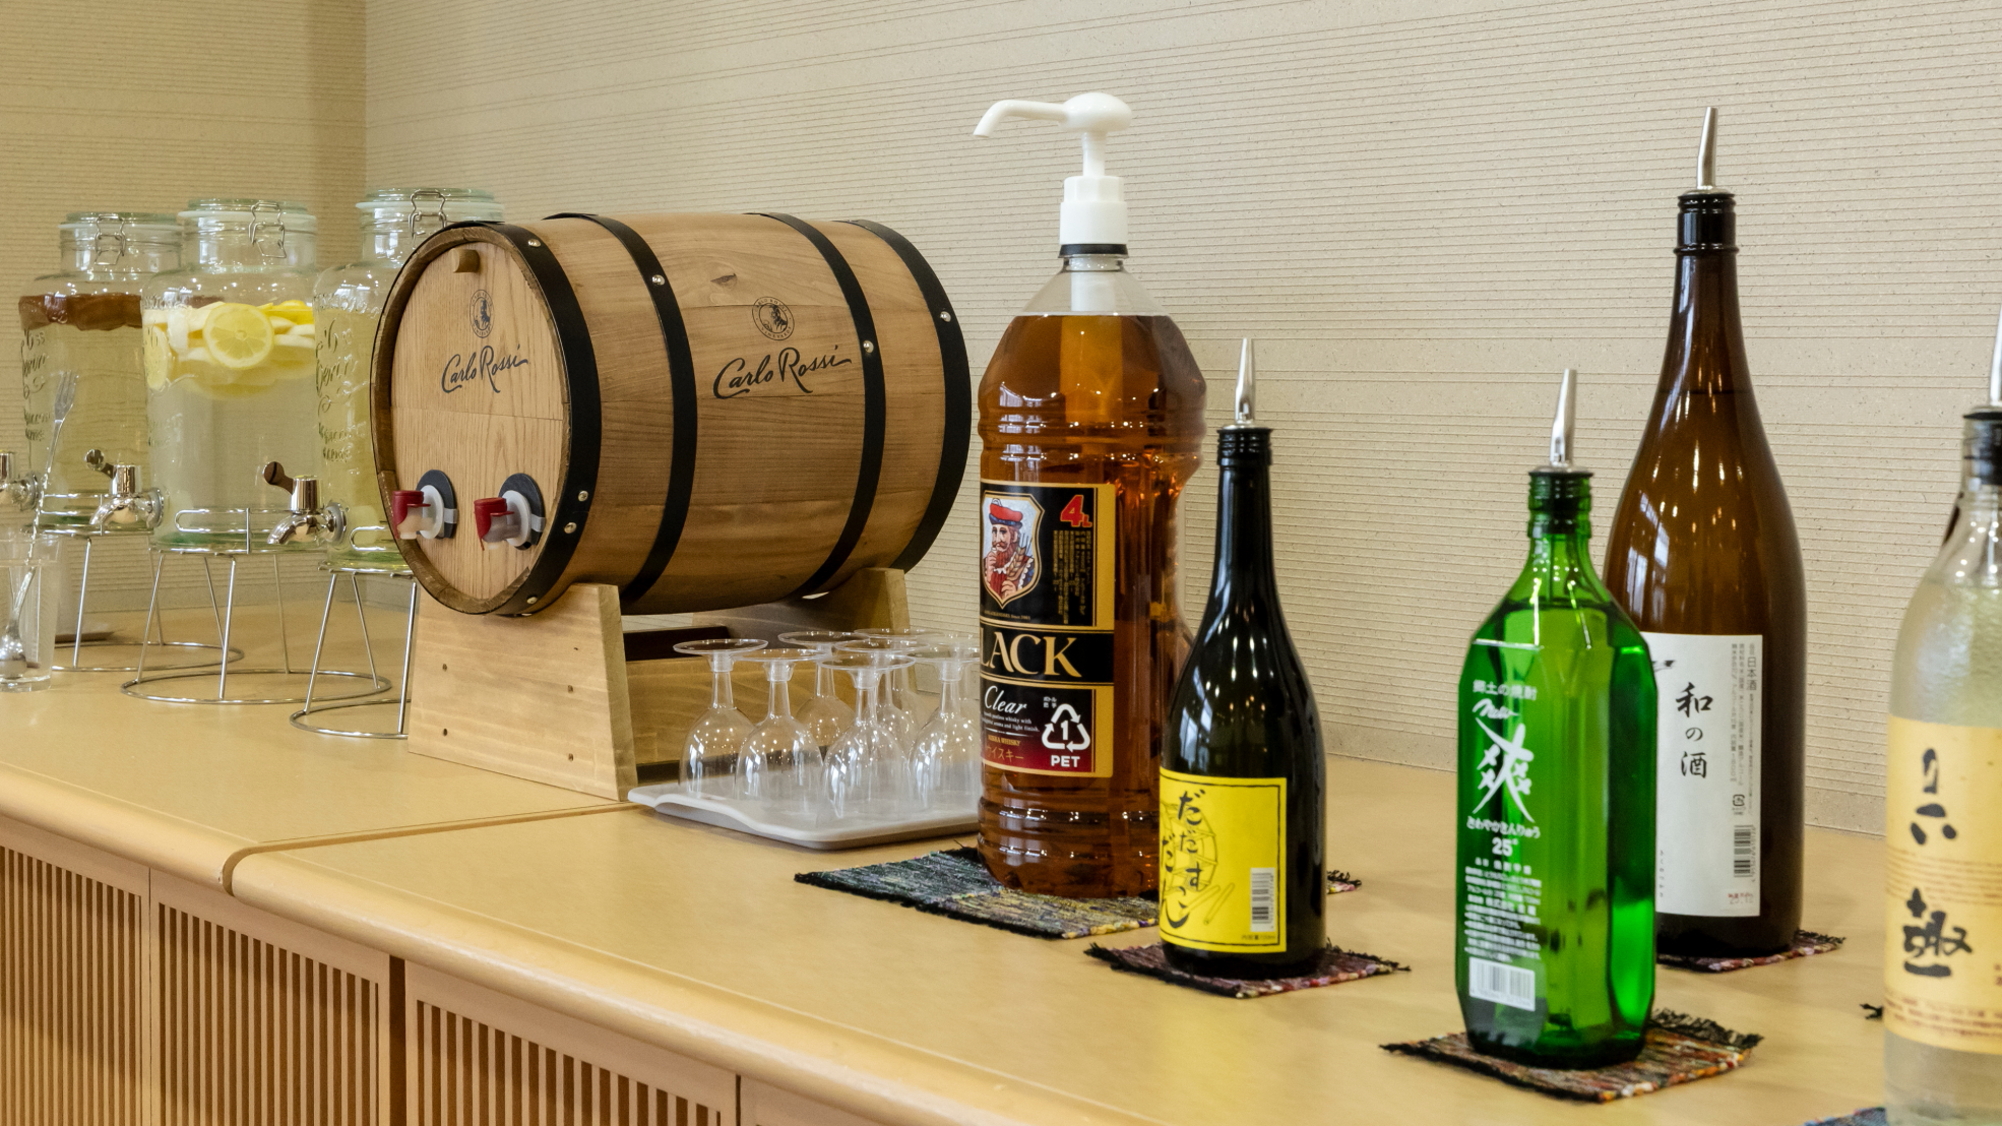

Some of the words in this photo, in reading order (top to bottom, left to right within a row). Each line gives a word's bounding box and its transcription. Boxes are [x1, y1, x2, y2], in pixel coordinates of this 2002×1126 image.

[441, 354, 478, 394] Carlo
[475, 343, 529, 394] Rossi
[712, 356, 776, 400] Carlo
[775, 343, 852, 395] Rossi
[1746, 656, 1757, 691] 日本酒
[984, 685, 1028, 714] Clear
[1001, 736, 1021, 747] WHISKY
[1675, 681, 1714, 779] 和の酒
[1051, 755, 1080, 768] PET
[1471, 716, 1536, 824] 爽
